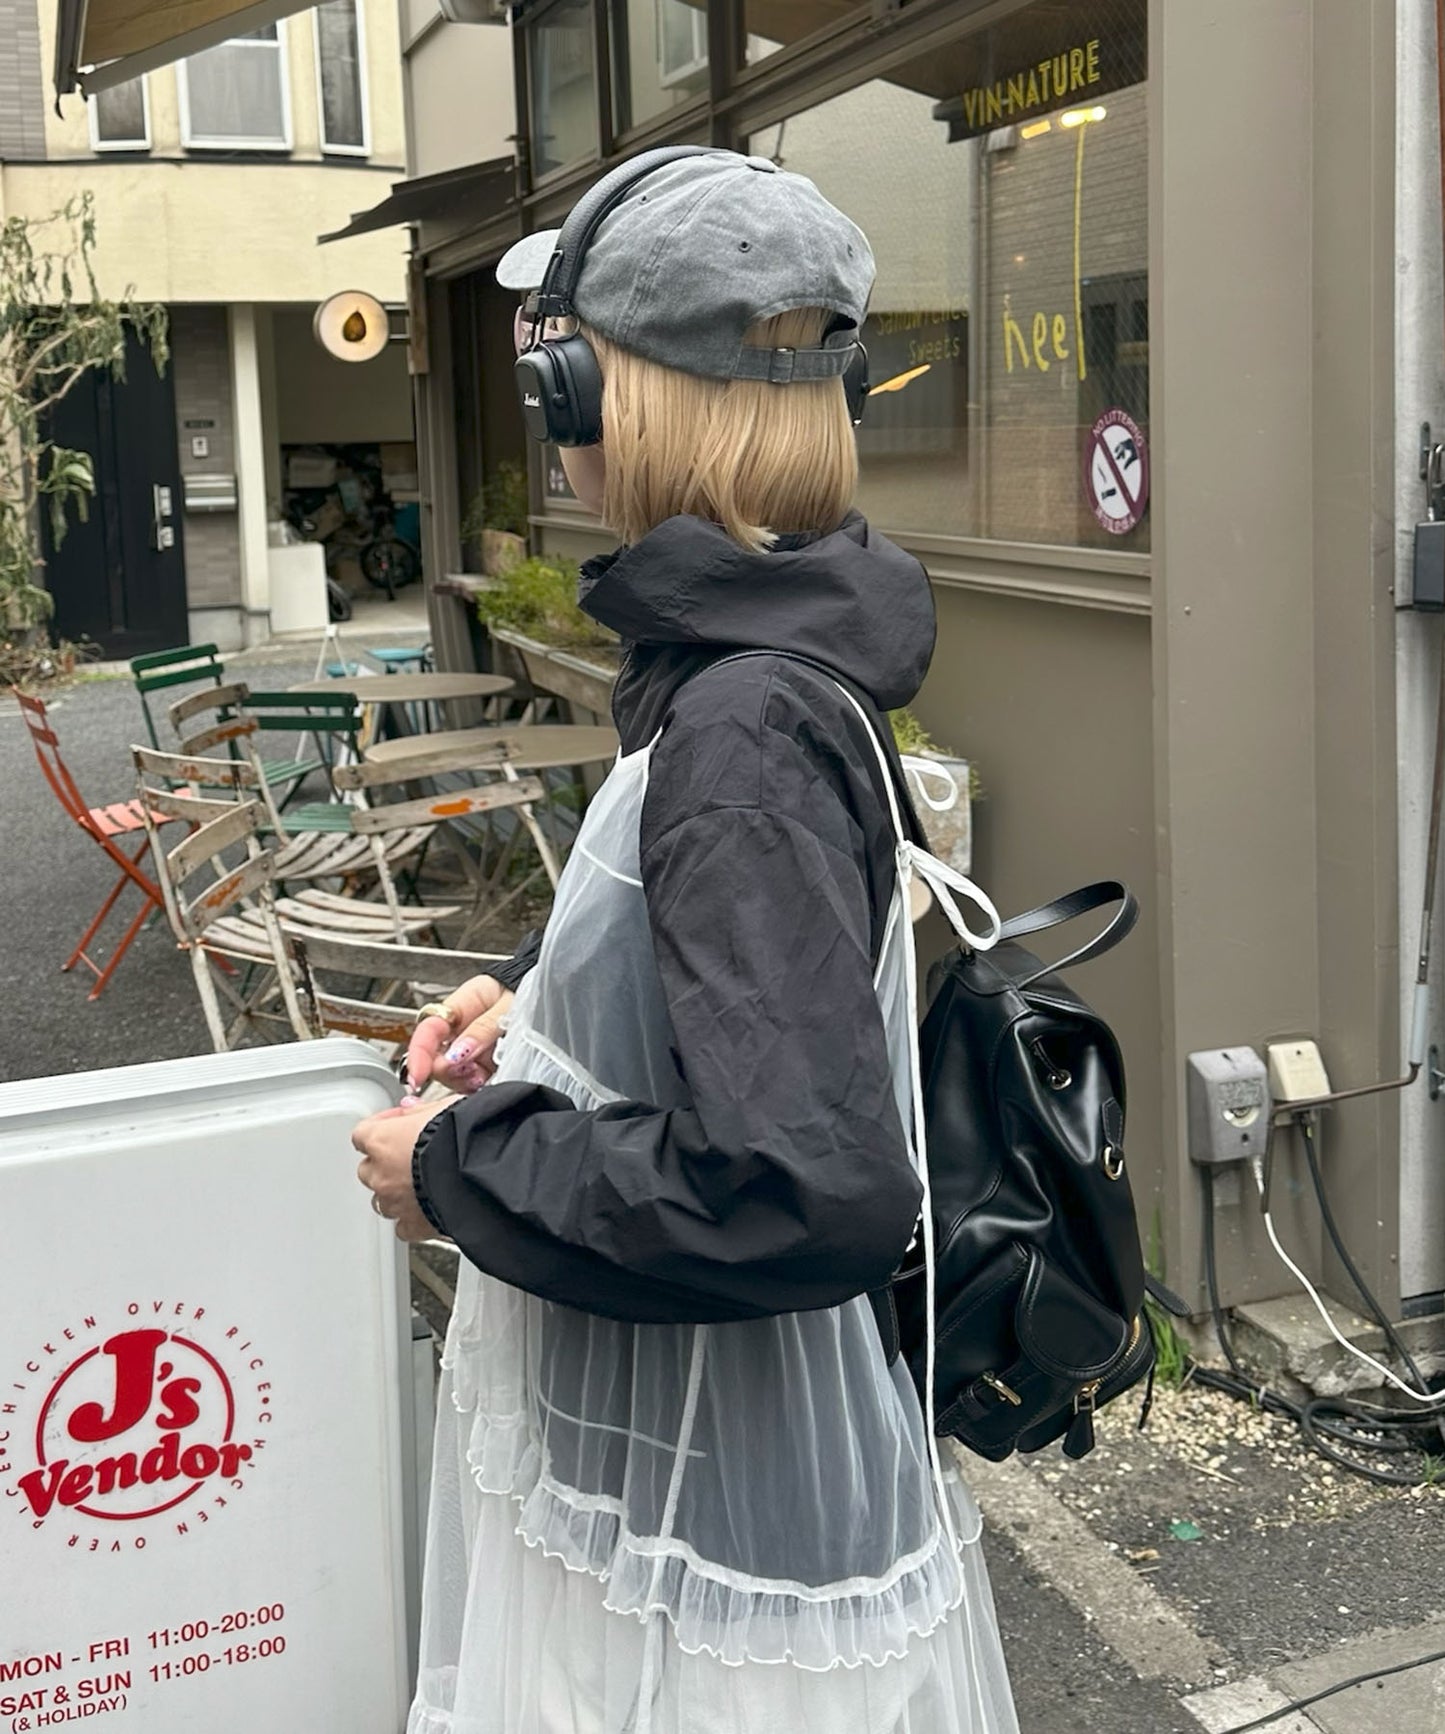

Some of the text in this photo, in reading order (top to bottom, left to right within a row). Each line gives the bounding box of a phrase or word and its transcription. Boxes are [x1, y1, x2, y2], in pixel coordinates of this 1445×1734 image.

[963, 39, 1100, 129] VIN-NATURE
[67, 1328, 202, 1443] J's
[127, 1301, 205, 1320] OVER
[225, 1326, 271, 1391] RICE
[18, 1432, 253, 1517] Vendor
[0, 1652, 62, 1682] MON
[89, 1637, 130, 1662] FRI
[147, 1603, 285, 1649] 11:00-20:00
[0, 1636, 286, 1716] SAT & SUN 11:00-18:00
[37, 1694, 128, 1728] HOLIDAY)
